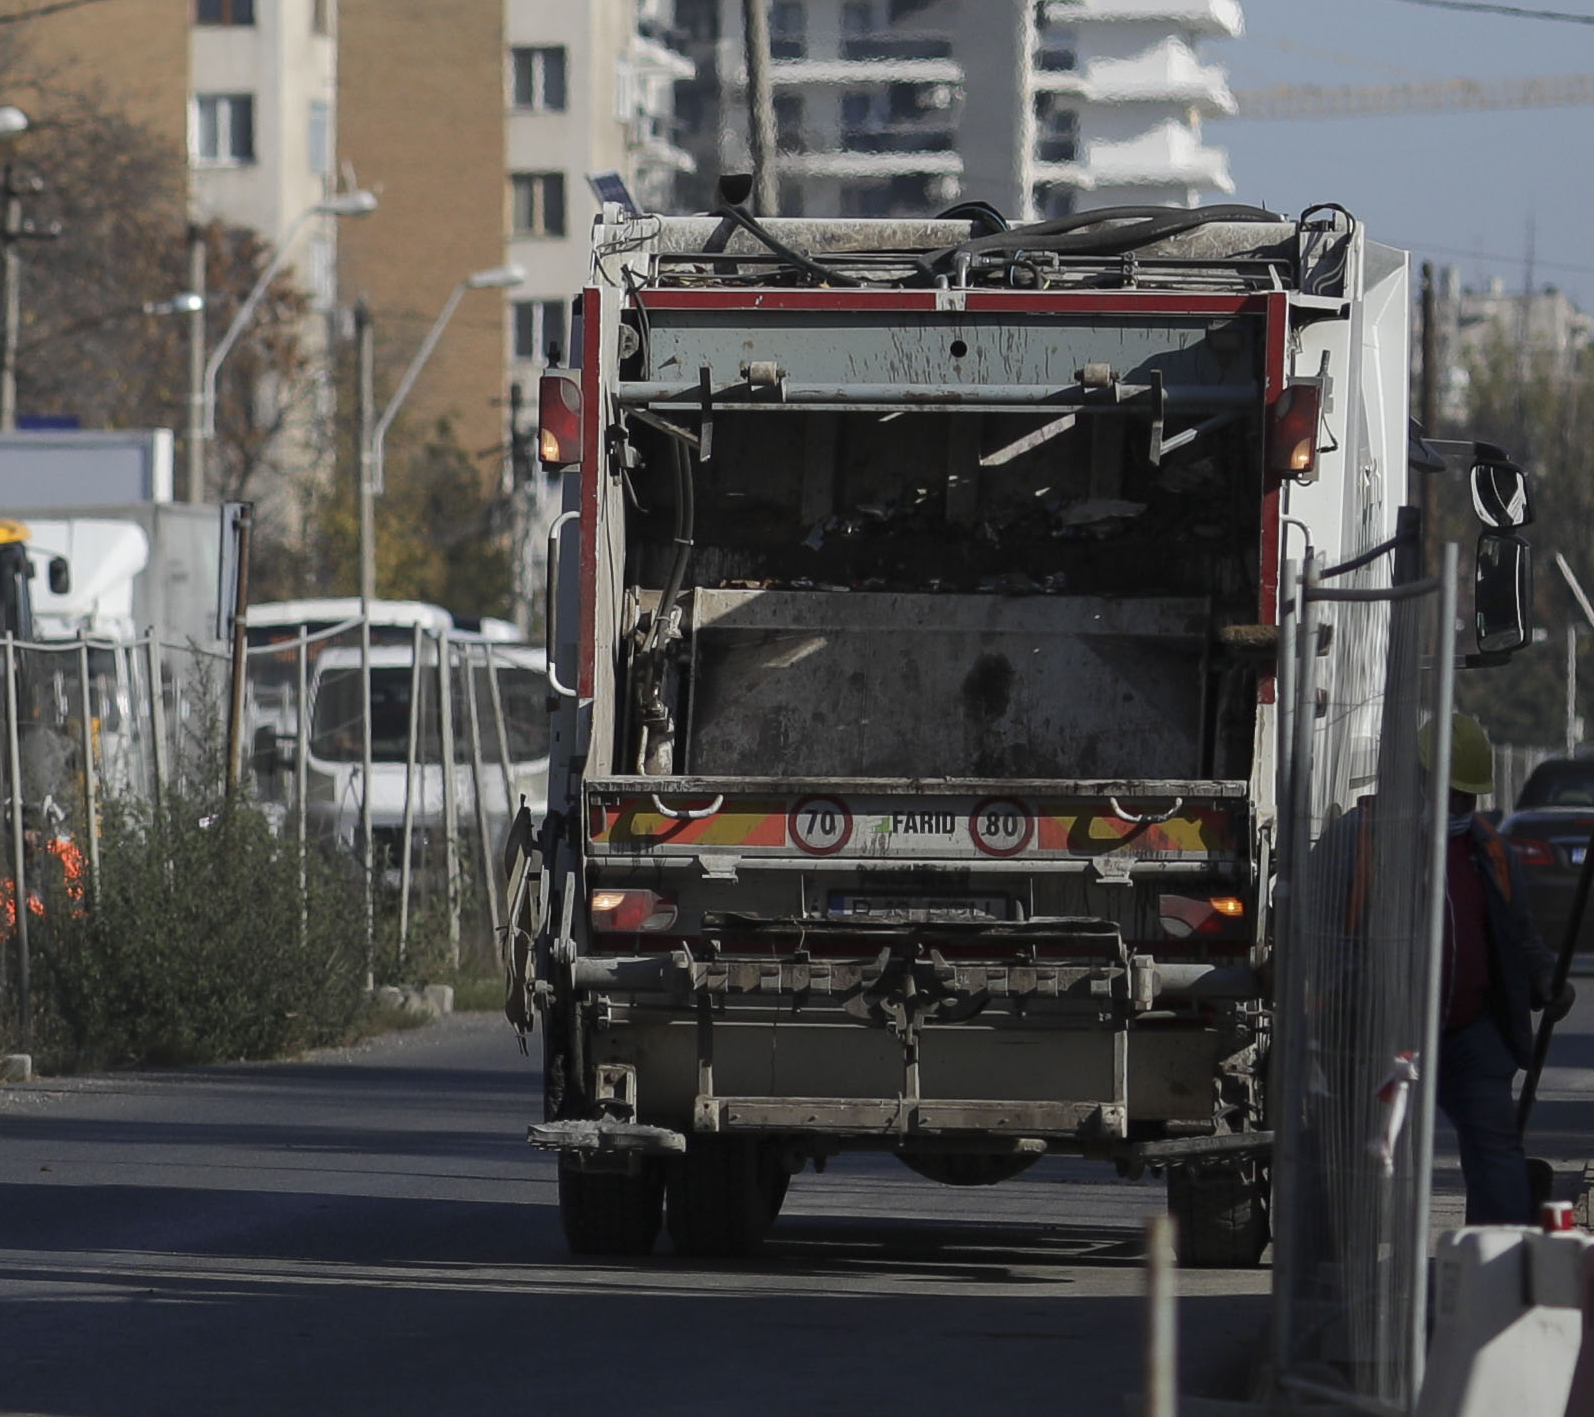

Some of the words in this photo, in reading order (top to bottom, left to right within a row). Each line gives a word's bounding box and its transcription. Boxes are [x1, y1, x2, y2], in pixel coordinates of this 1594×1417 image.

[805, 810, 836, 835] 70
[892, 810, 956, 834] FARID
[985, 812, 1017, 837] 80
